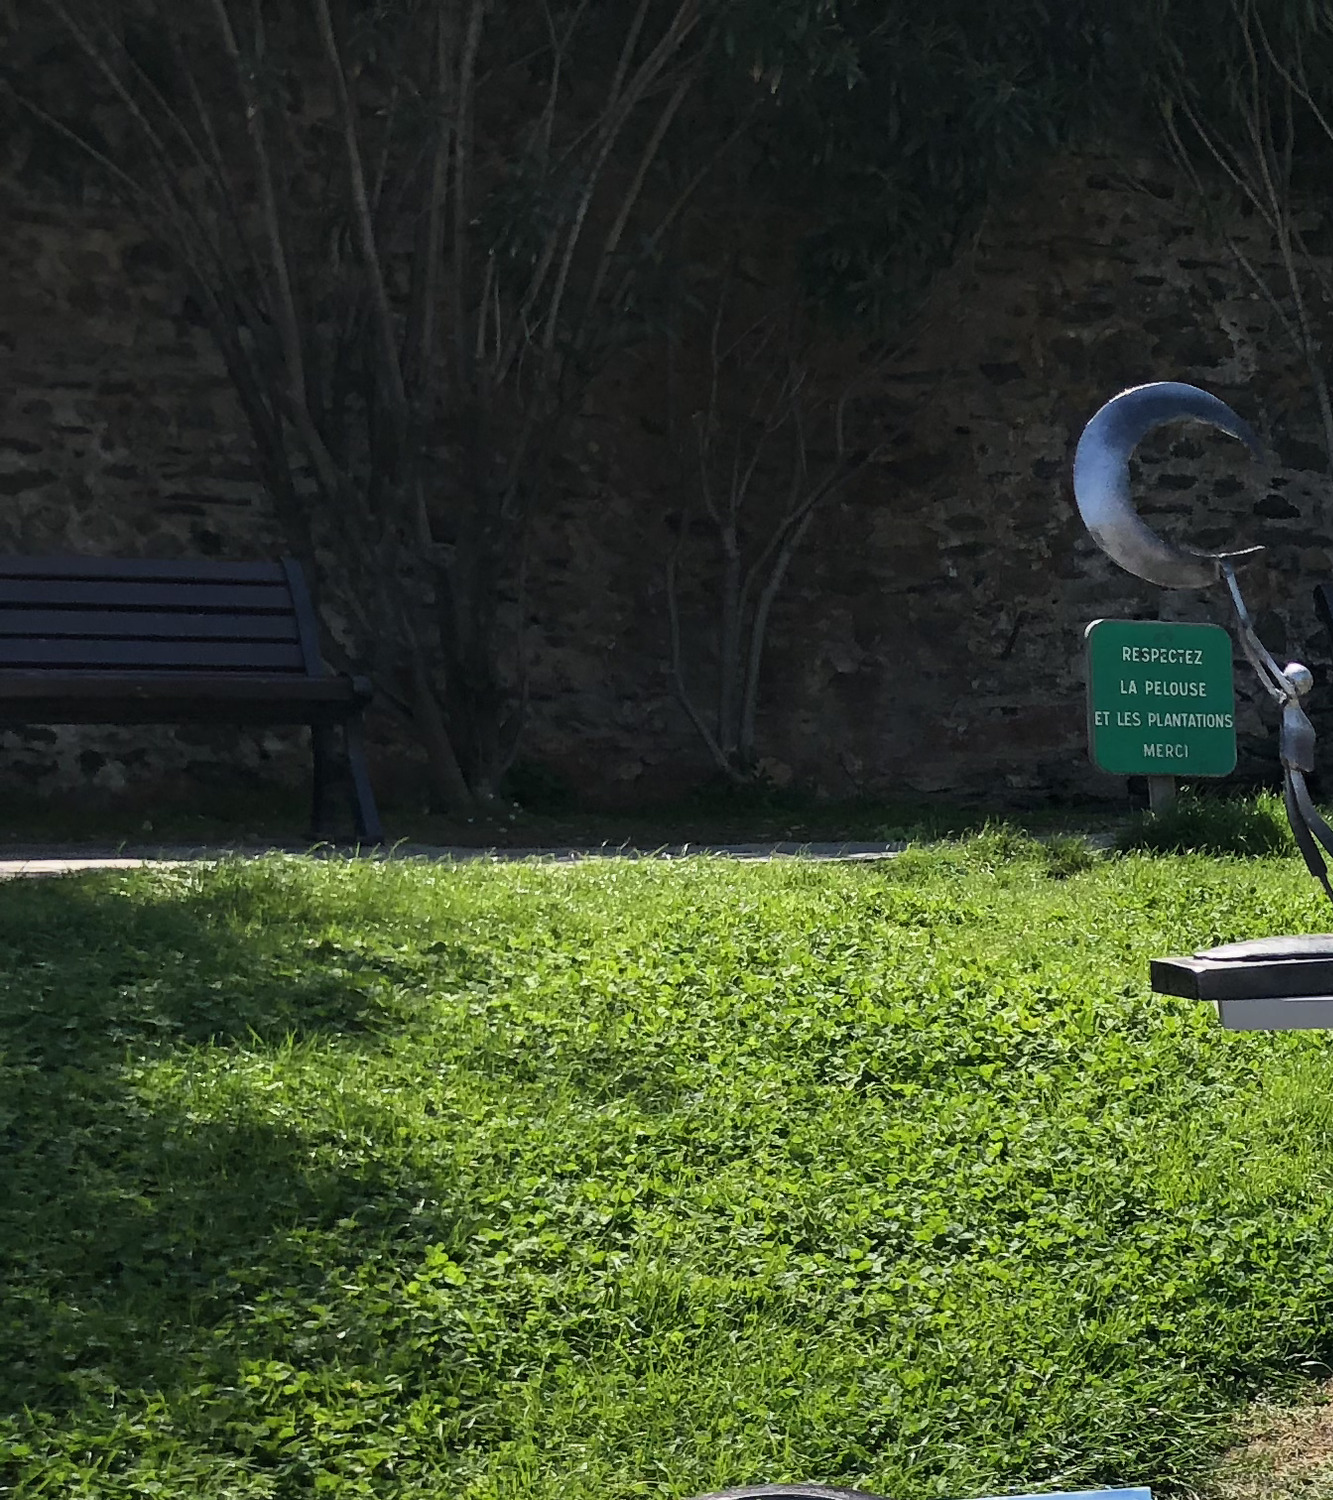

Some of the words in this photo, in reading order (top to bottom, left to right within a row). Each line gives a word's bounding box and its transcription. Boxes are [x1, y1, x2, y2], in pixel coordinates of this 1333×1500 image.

[1122, 646, 1203, 665] RESPECTEZ
[1120, 680, 1138, 695] LA
[1145, 681, 1207, 697] PELOUSE
[1094, 711, 1110, 726] ET
[1117, 711, 1141, 726] LES
[1148, 713, 1233, 728] PLANTATIONS
[1143, 743, 1189, 758] MERCI
